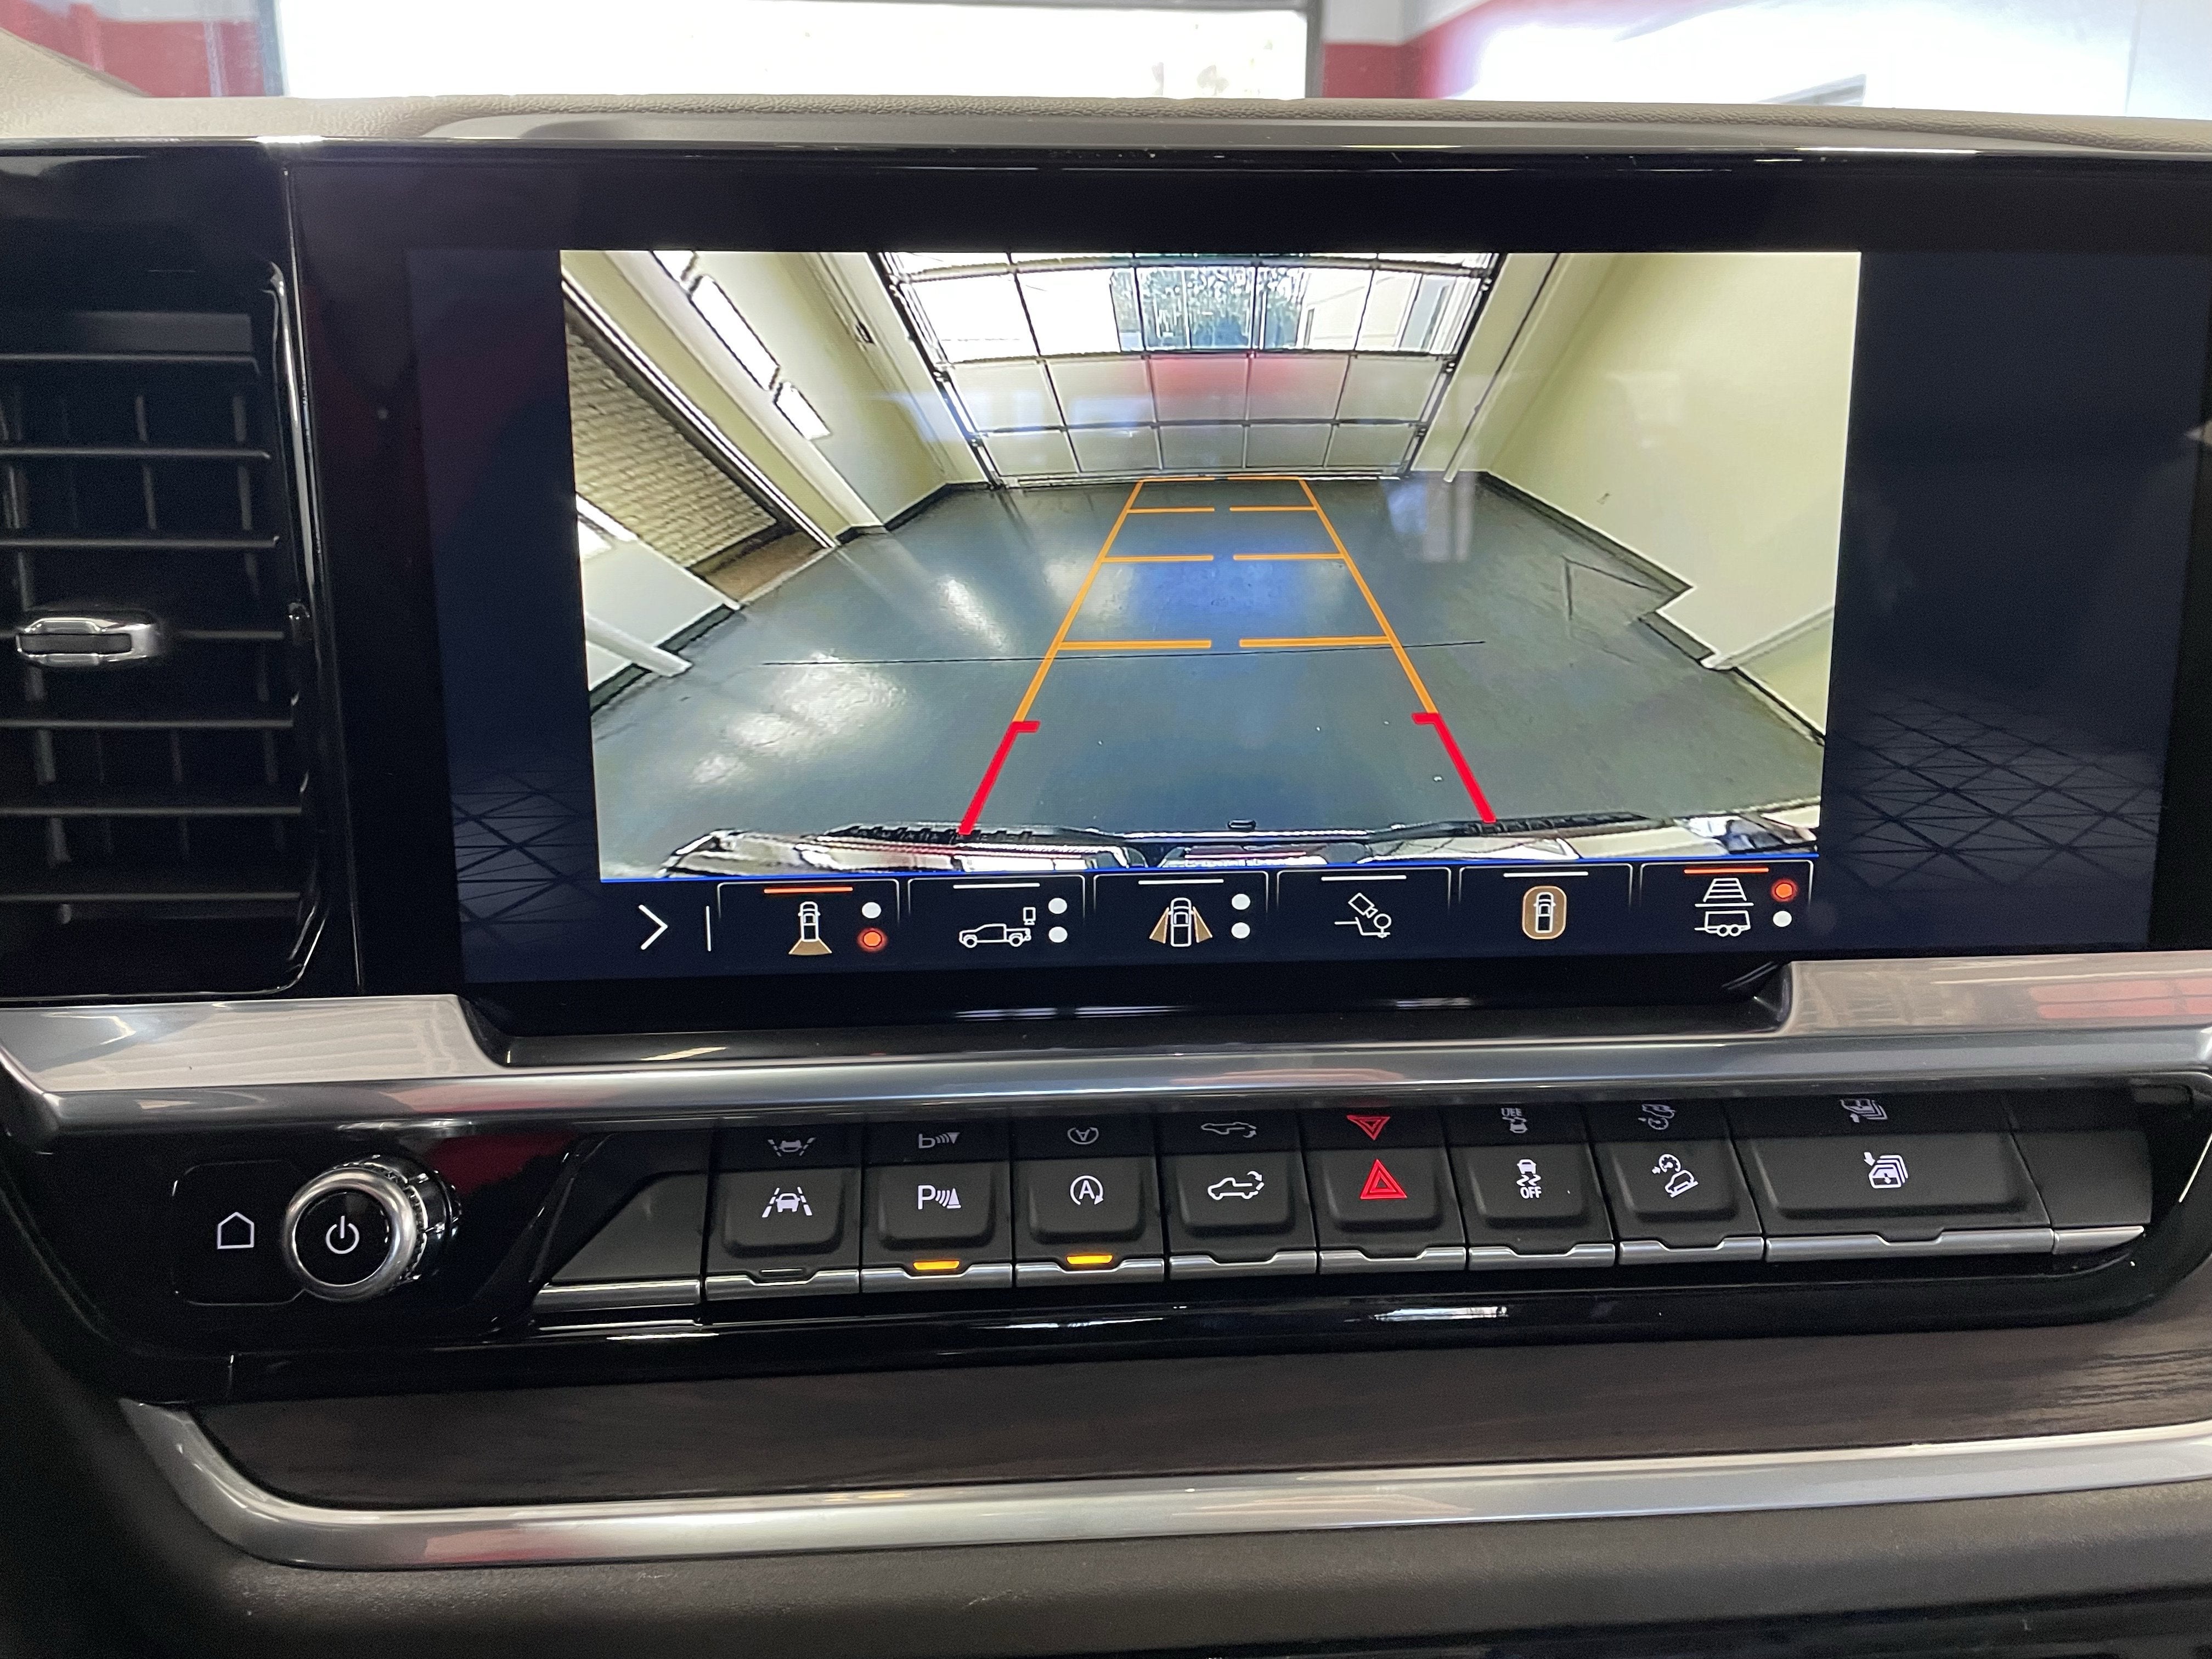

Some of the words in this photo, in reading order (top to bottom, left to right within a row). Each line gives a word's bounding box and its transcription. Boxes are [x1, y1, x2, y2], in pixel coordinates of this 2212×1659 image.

[917, 1184, 936, 1210] P
[1078, 1180, 1096, 1200] A
[1520, 1186, 1542, 1198] OFF
